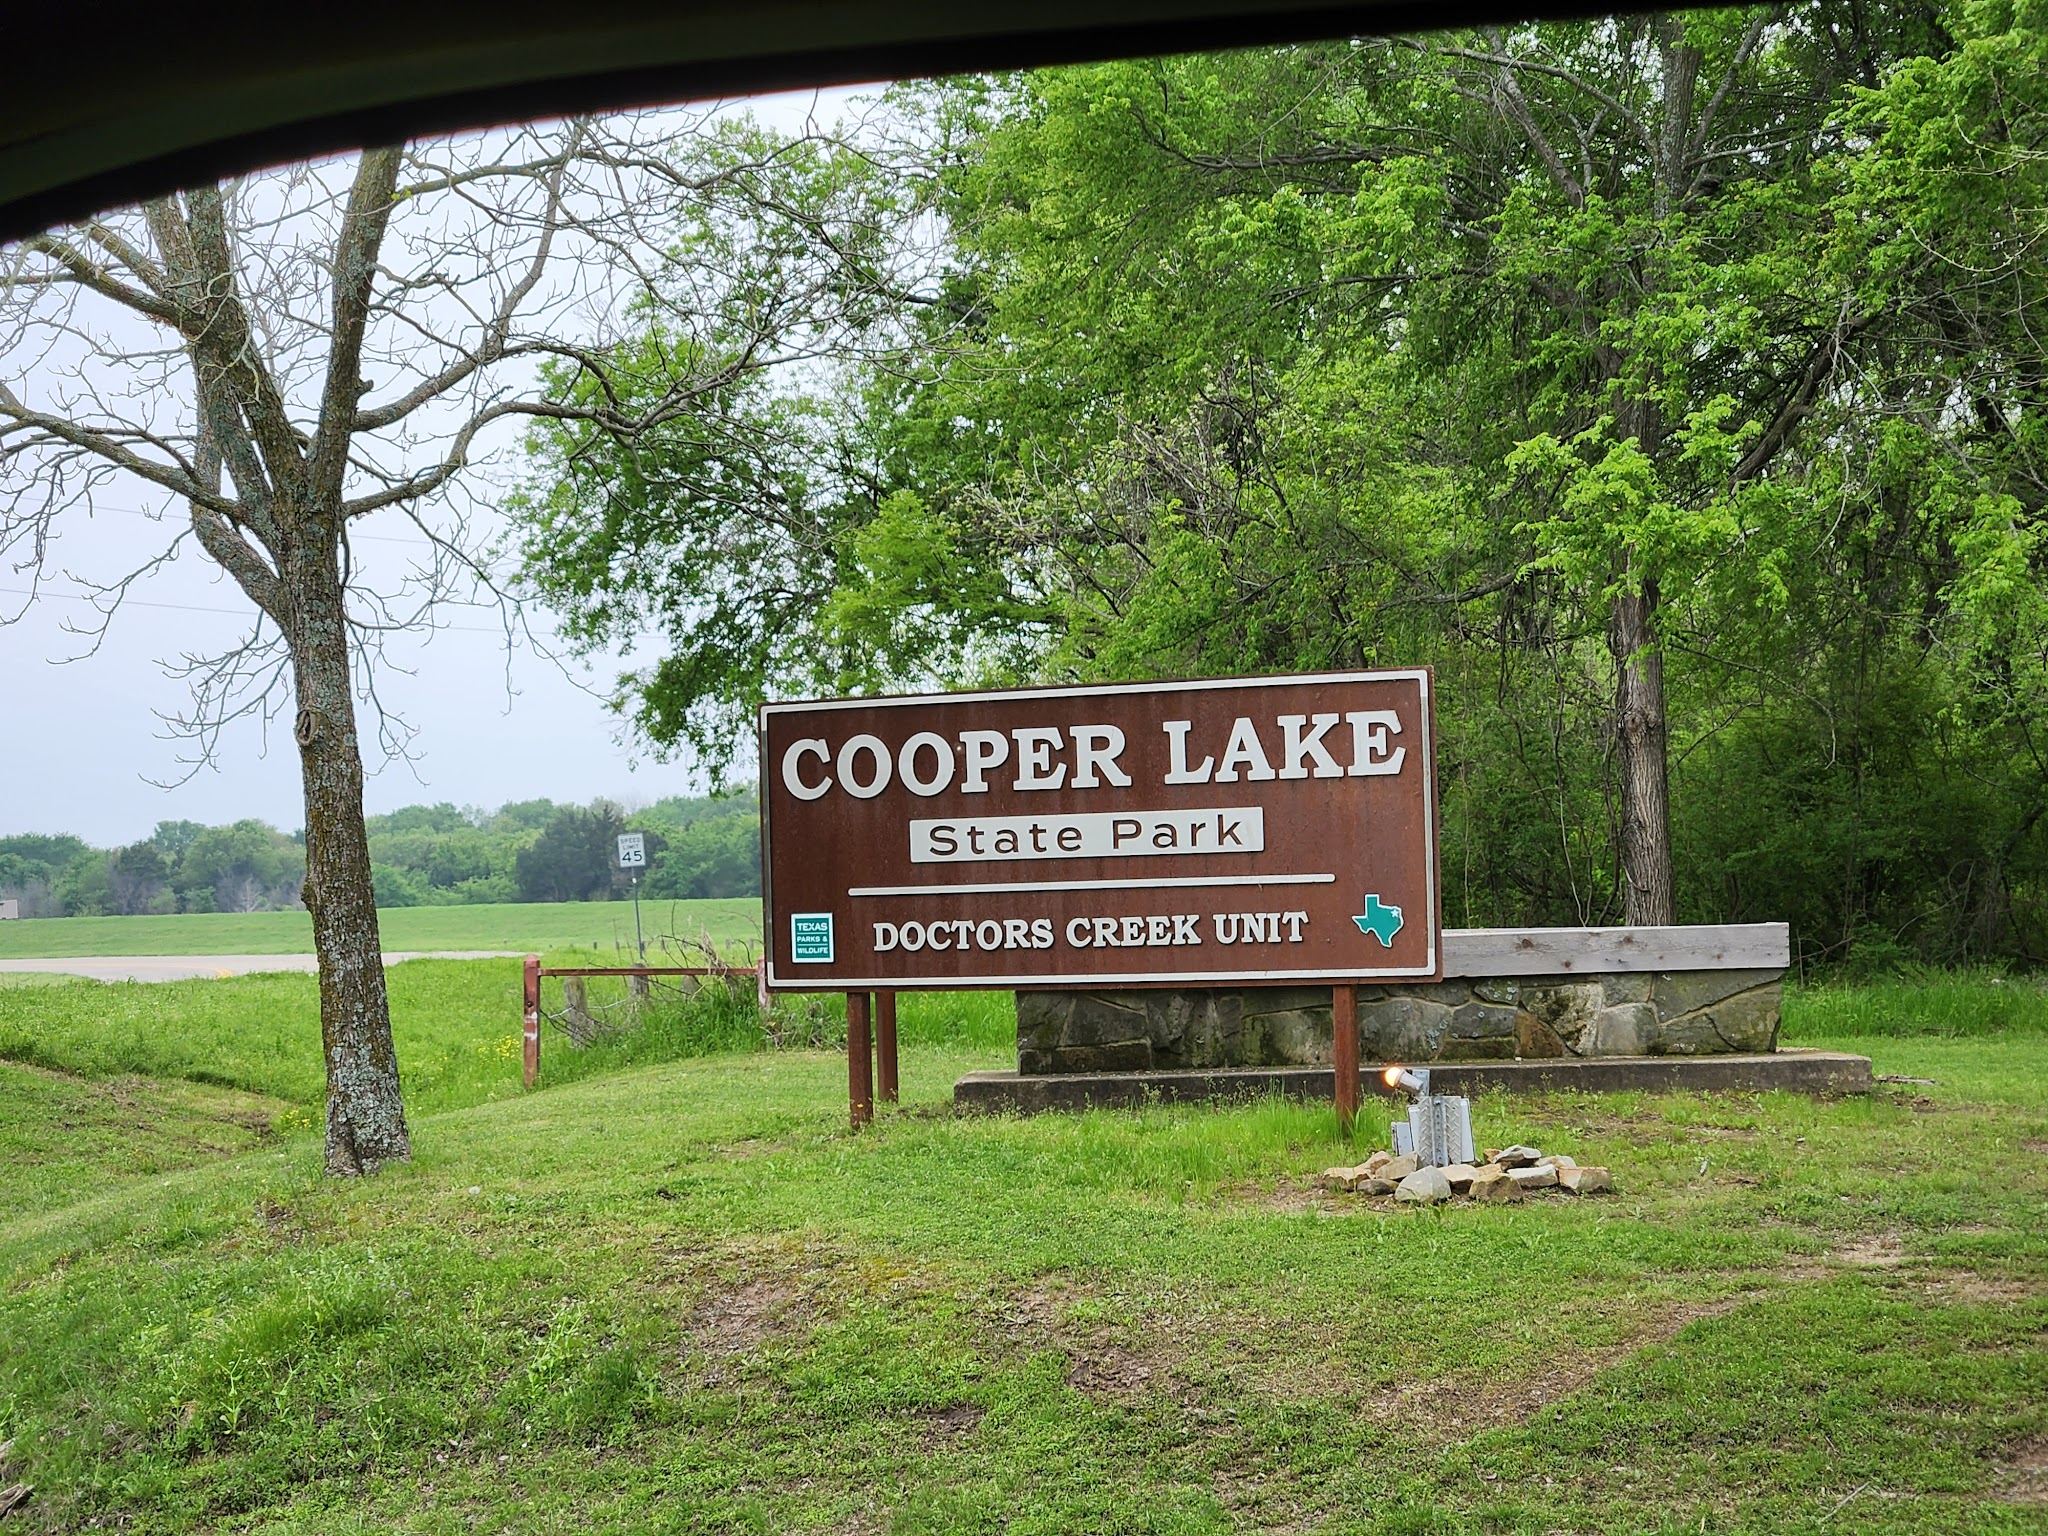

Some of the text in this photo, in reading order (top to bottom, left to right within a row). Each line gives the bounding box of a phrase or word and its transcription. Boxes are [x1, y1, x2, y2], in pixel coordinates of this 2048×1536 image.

[782, 710, 1406, 800] COOPER LAKE
[929, 814, 1243, 856] State Park
[622, 850, 643, 862] 45
[797, 922, 828, 931] TEXAS
[873, 911, 1309, 952] DOCTORS CREEK UNIT
